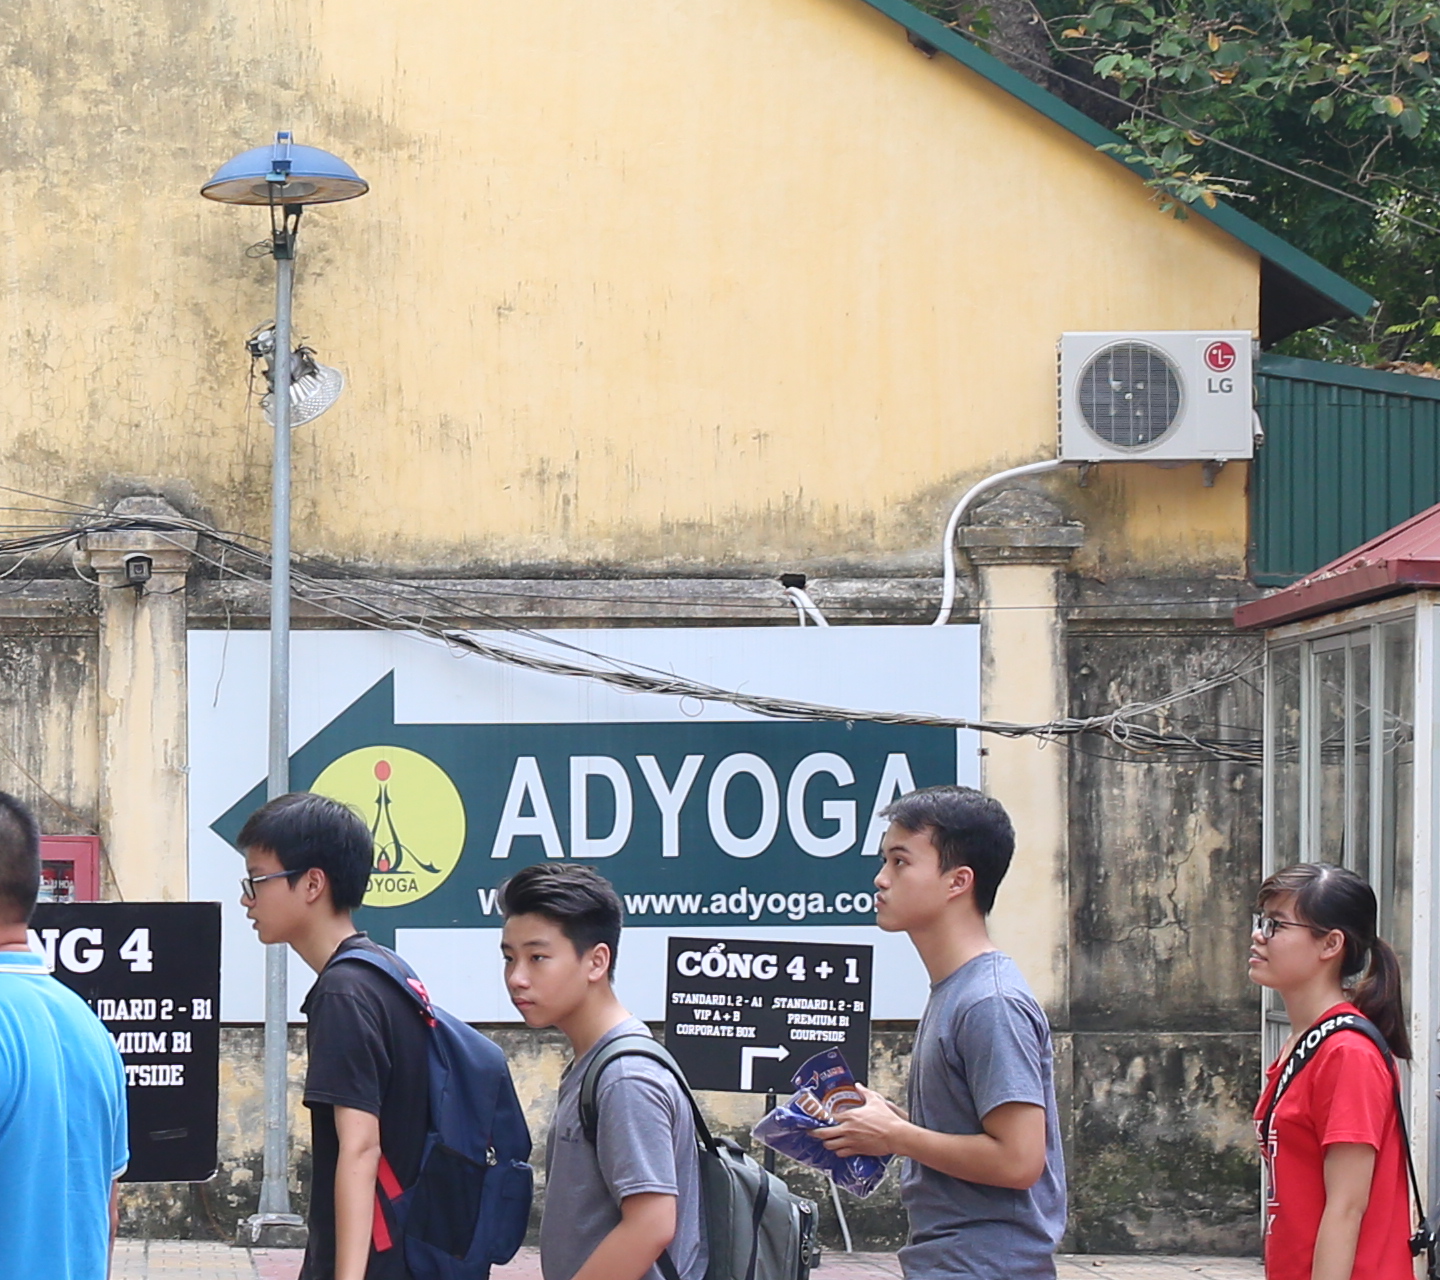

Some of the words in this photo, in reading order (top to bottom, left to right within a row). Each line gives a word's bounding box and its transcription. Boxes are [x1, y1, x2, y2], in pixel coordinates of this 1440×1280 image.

[1207, 378, 1233, 394] LG
[490, 752, 917, 859] ADYOGA
[363, 877, 419, 893] DYOGA
[26, 927, 105, 973] NG
[120, 927, 154, 972] 4
[676, 942, 779, 980] CỔNG
[786, 956, 806, 981] 4
[844, 958, 860, 984] 1
[671, 992, 726, 1007] STANDARD
[736, 995, 743, 1007] 2
[751, 996, 763, 1008] A1
[773, 996, 828, 1011] STANDARD
[838, 1000, 846, 1012] 2
[853, 1000, 865, 1012] B1
[160, 998, 173, 1020] 2
[191, 998, 213, 1020] B1
[693, 1008, 712, 1020] VIP
[712, 1010, 721, 1022] A
[732, 1010, 741, 1022] B
[787, 1013, 837, 1026] PREMIUM
[838, 1015, 850, 1027] B1
[676, 1024, 734, 1037] CORPORATE
[735, 1026, 756, 1038] BOX
[790, 1029, 846, 1042] COURTSIDE
[171, 1032, 192, 1053] B1
[1273, 1057, 1295, 1106] EW
[1295, 1014, 1355, 1060] YORK
